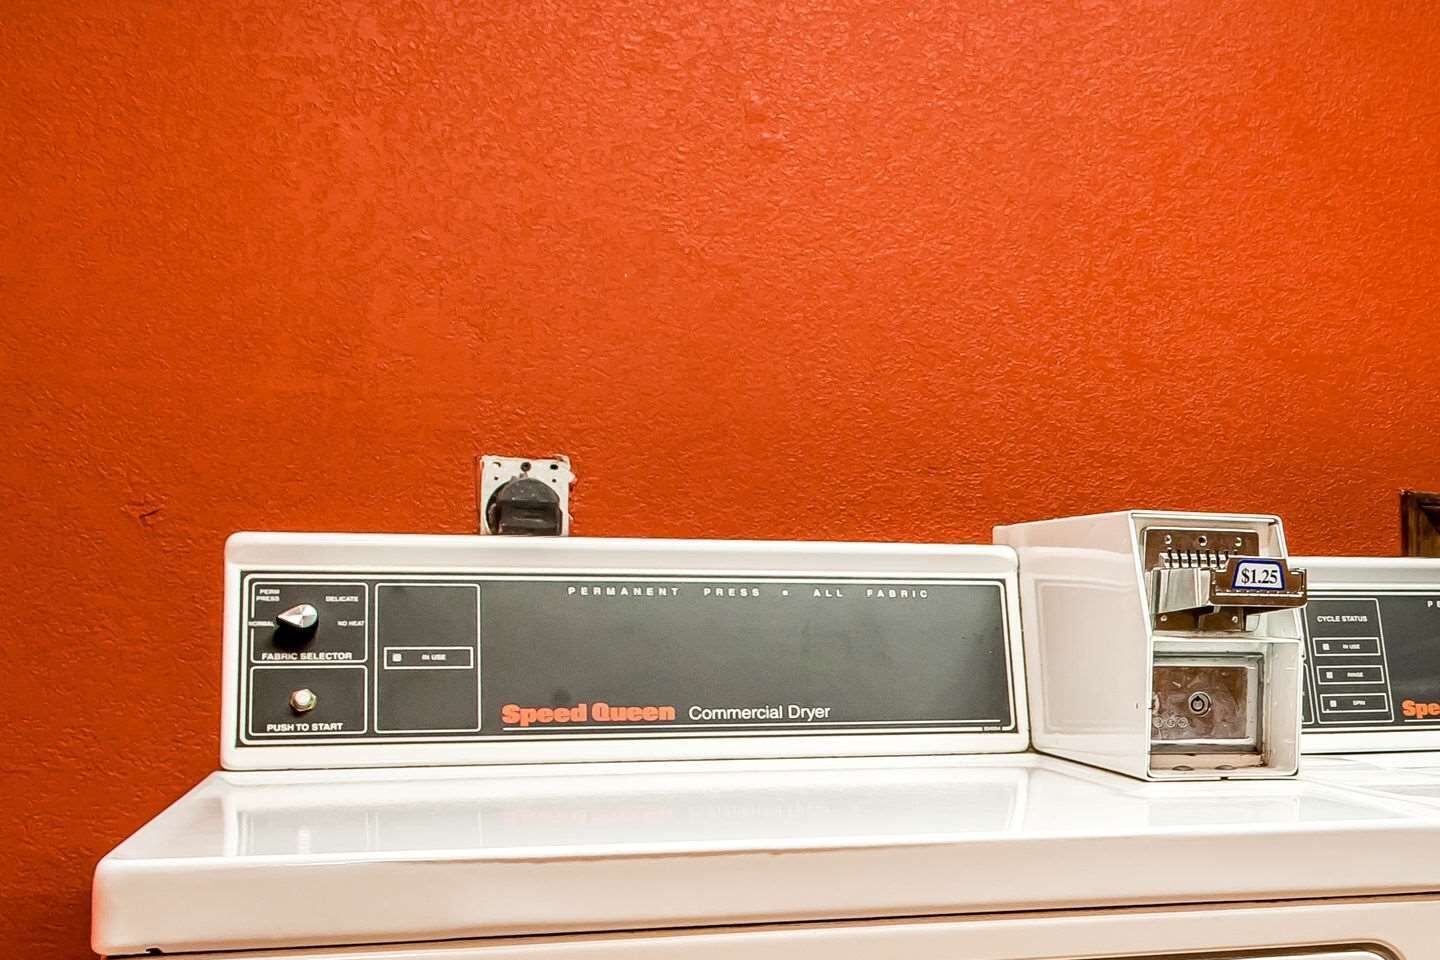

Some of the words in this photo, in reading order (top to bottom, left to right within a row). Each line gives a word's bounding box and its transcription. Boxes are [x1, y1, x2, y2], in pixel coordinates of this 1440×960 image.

[1241, 568, 1278, 585] $1.25
[567, 586, 680, 597] PERMANENT
[703, 587, 761, 598] PRESS
[813, 588, 844, 598] ALL
[866, 589, 930, 599] FABRIC
[262, 652, 298, 660] FABRIC
[300, 652, 352, 660] SELECTOR
[502, 703, 588, 727] Speed
[591, 702, 676, 722] Queen
[688, 705, 783, 720] Commercial
[788, 705, 831, 722] Dryer
[266, 723, 295, 732] PUSH
[296, 723, 309, 731] TO
[311, 722, 344, 731] START
